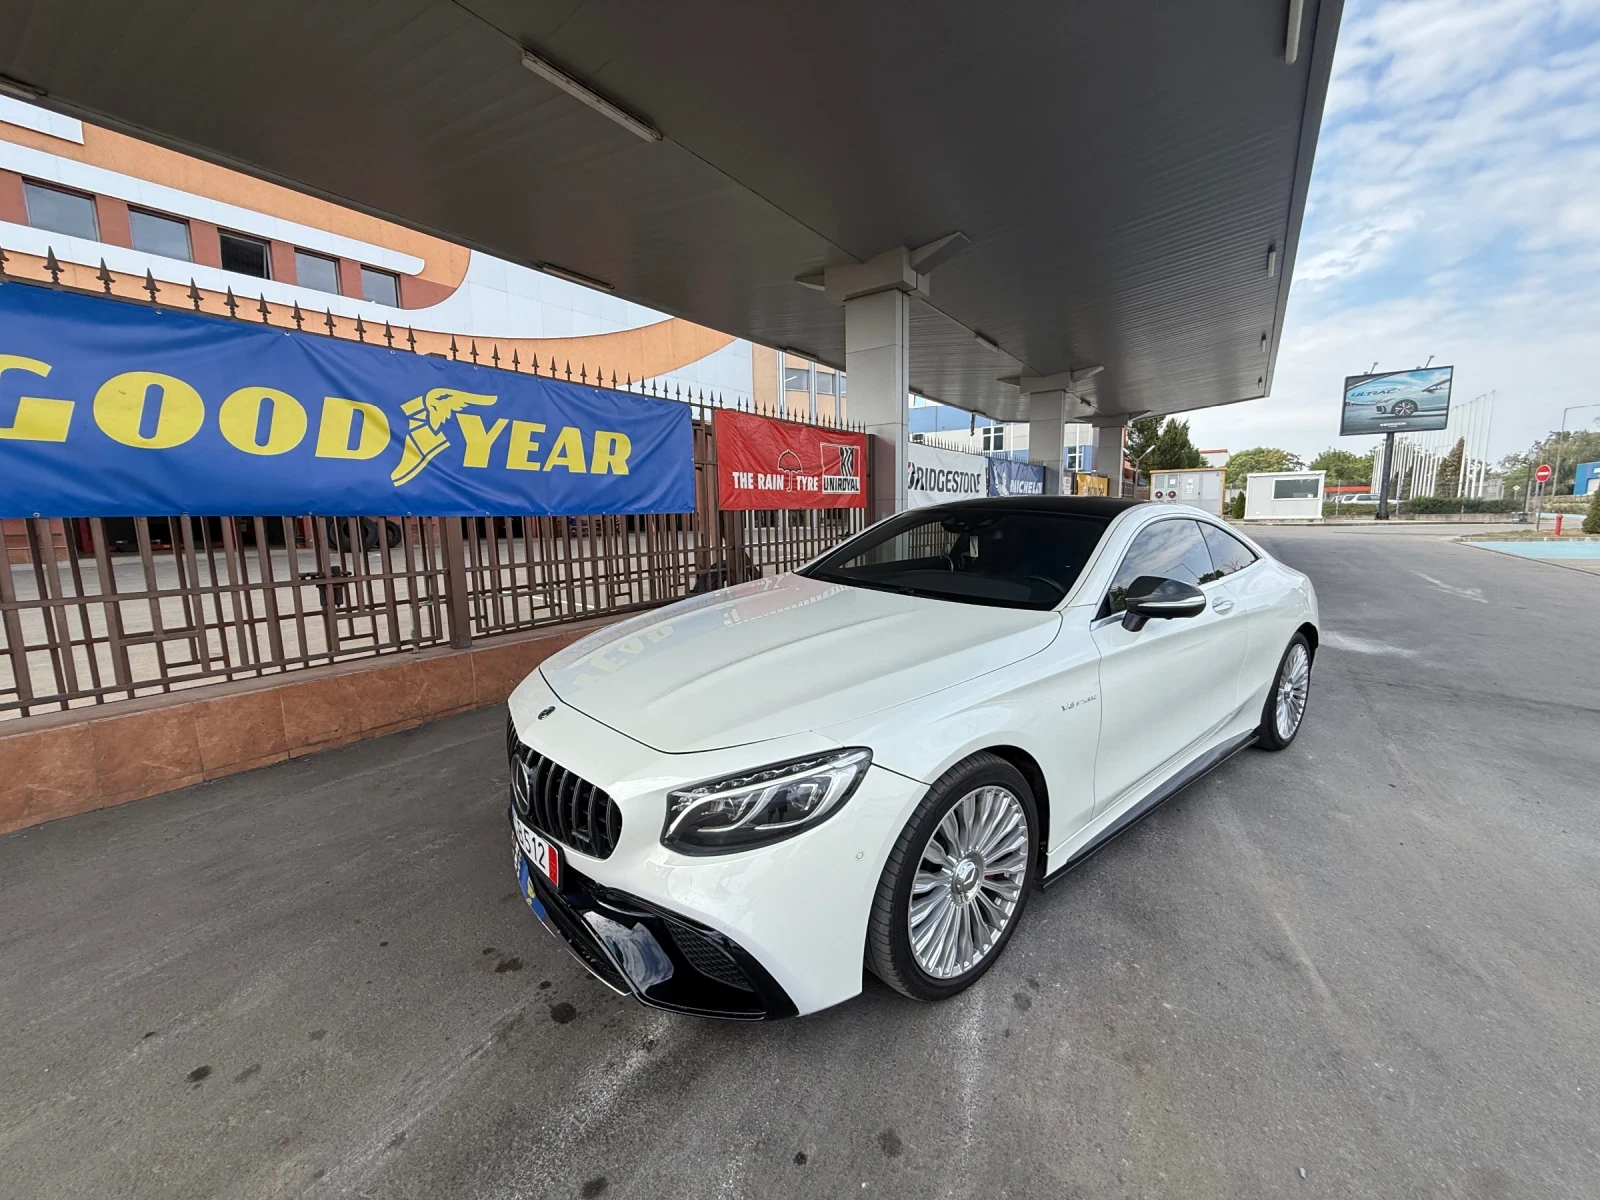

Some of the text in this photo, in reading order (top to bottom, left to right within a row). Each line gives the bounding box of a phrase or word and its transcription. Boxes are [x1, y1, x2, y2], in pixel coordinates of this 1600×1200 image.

[455, 414, 632, 476] YEAR
[732, 472, 819, 491] THE RAIN TYRE
[823, 477, 860, 492] UNIROYAL
